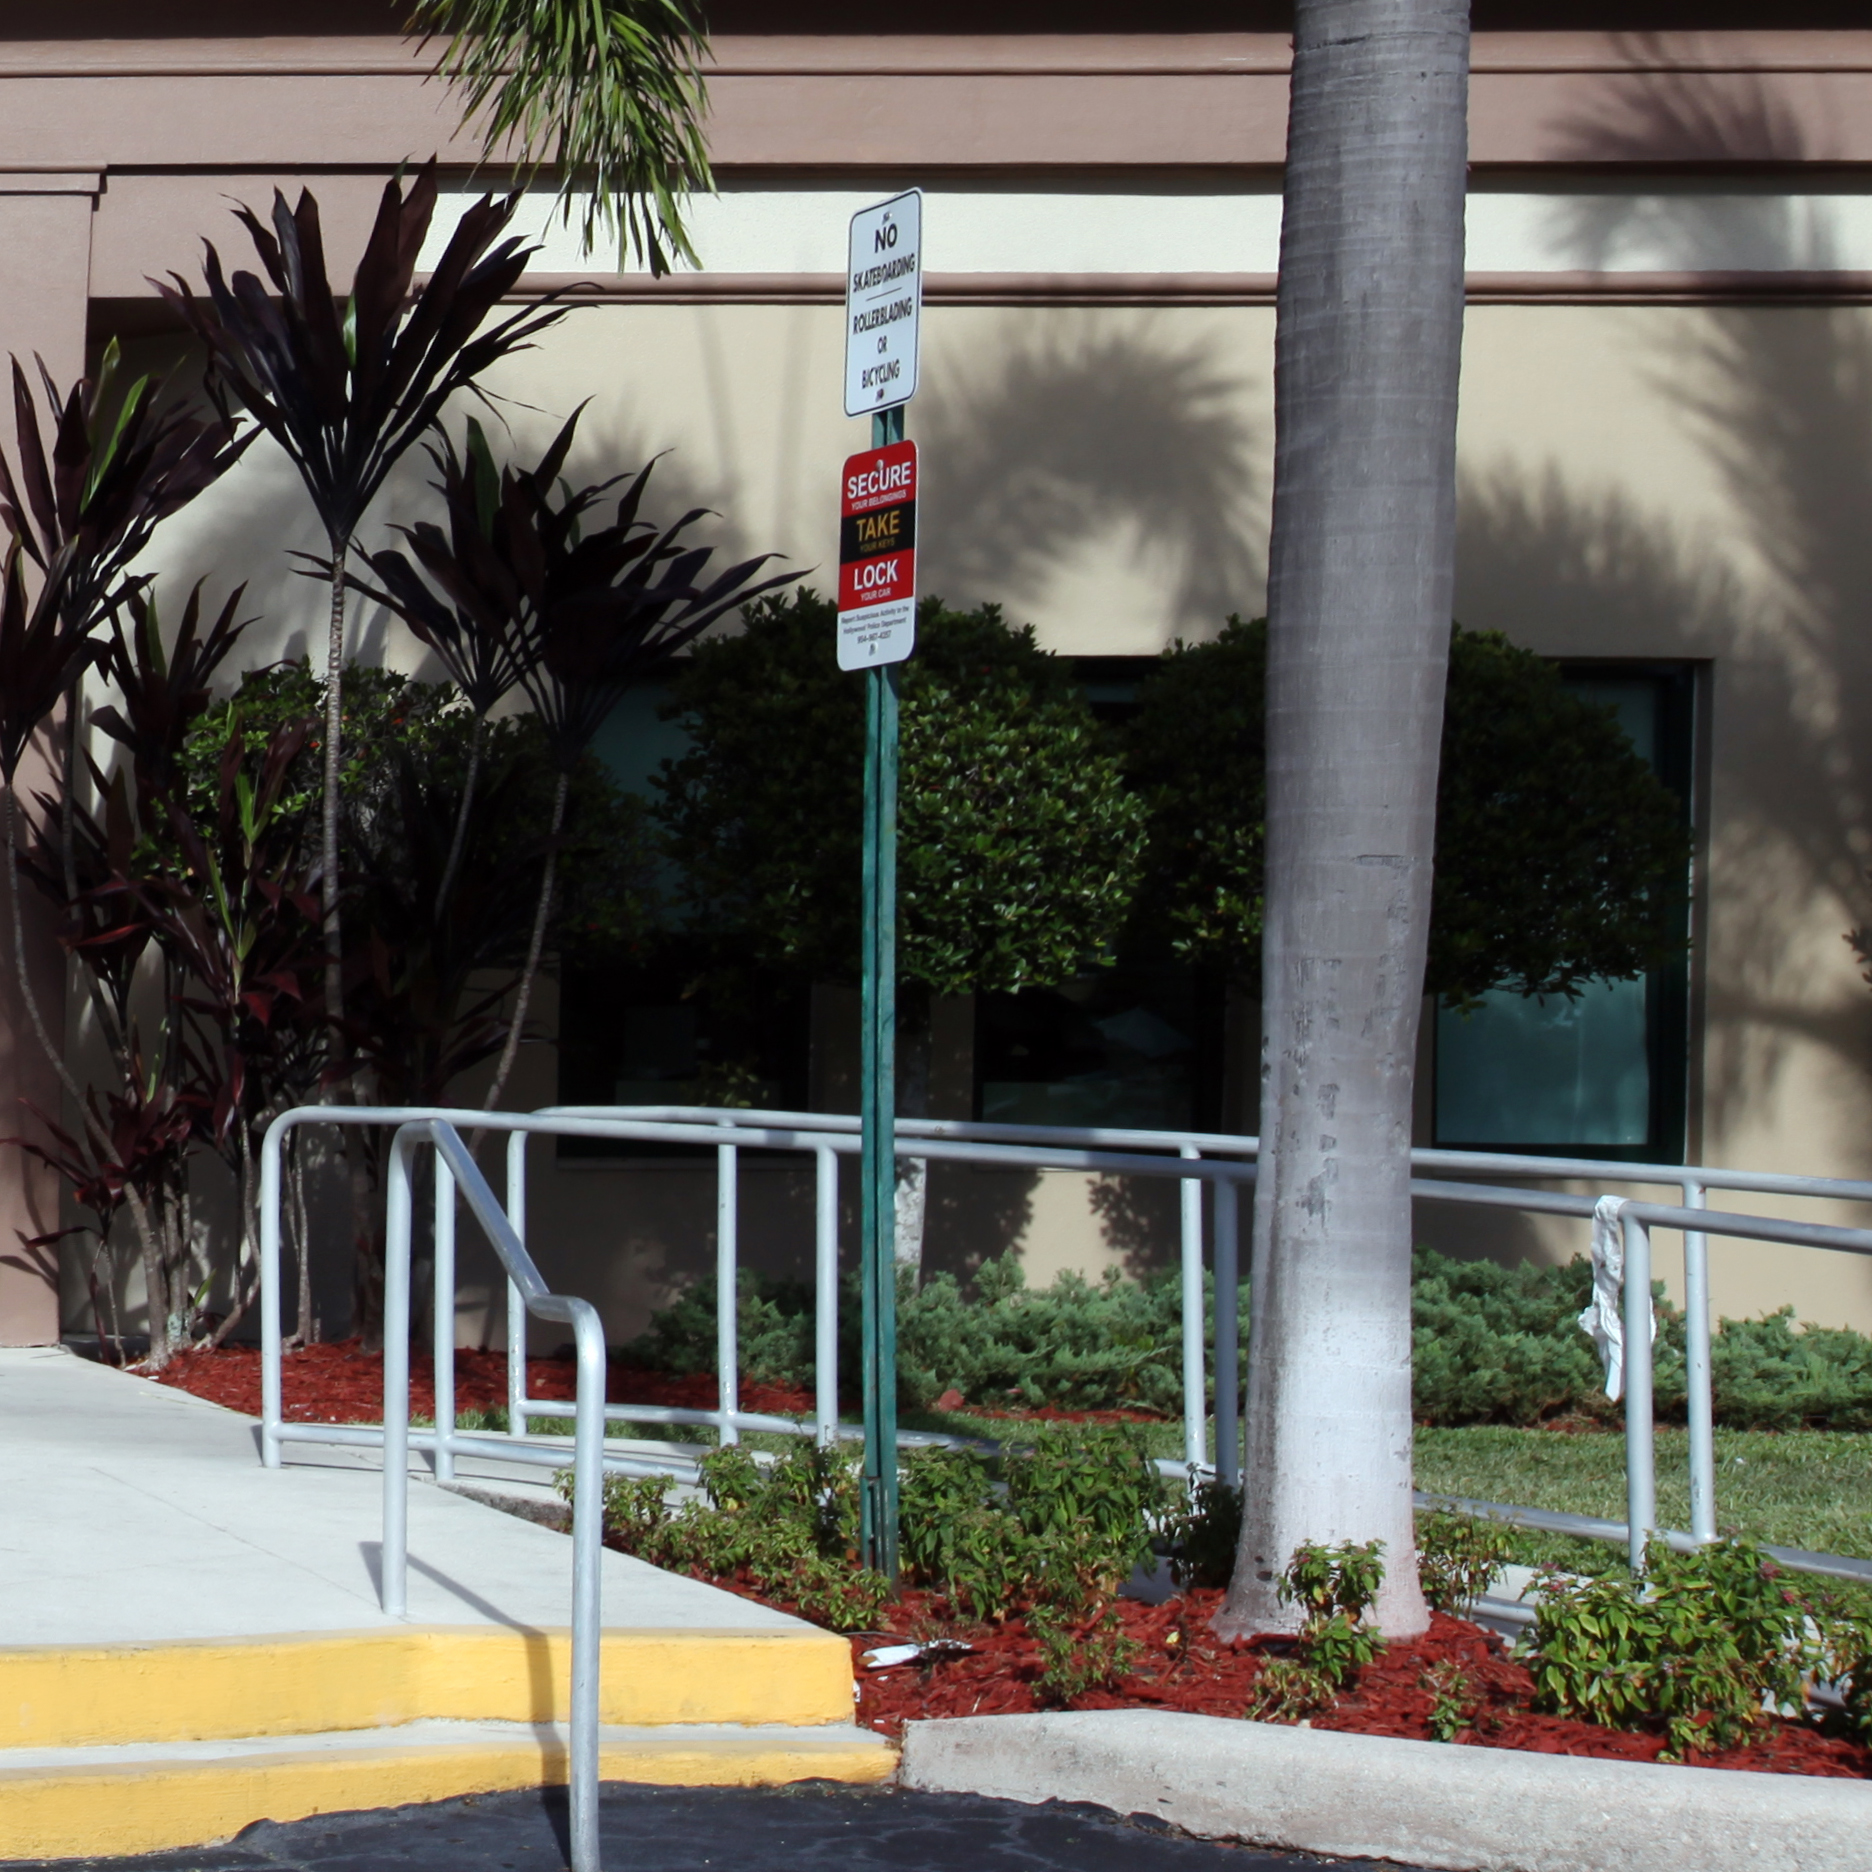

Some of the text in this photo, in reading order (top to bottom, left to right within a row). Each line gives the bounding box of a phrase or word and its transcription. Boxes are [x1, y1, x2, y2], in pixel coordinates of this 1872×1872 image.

[874, 222, 898, 254] NO
[853, 252, 917, 294] SKATEBOARDING
[853, 296, 914, 336] ROLLERBLADING
[877, 335, 888, 355] OR
[861, 359, 901, 390] BICYCLING
[847, 461, 912, 500] SECURE
[851, 497, 868, 512] YOUR
[856, 509, 901, 543] TAKE
[859, 536, 895, 554] YOUR KEYS
[854, 558, 899, 591] LOCK
[860, 587, 891, 602] YOUR CAR
